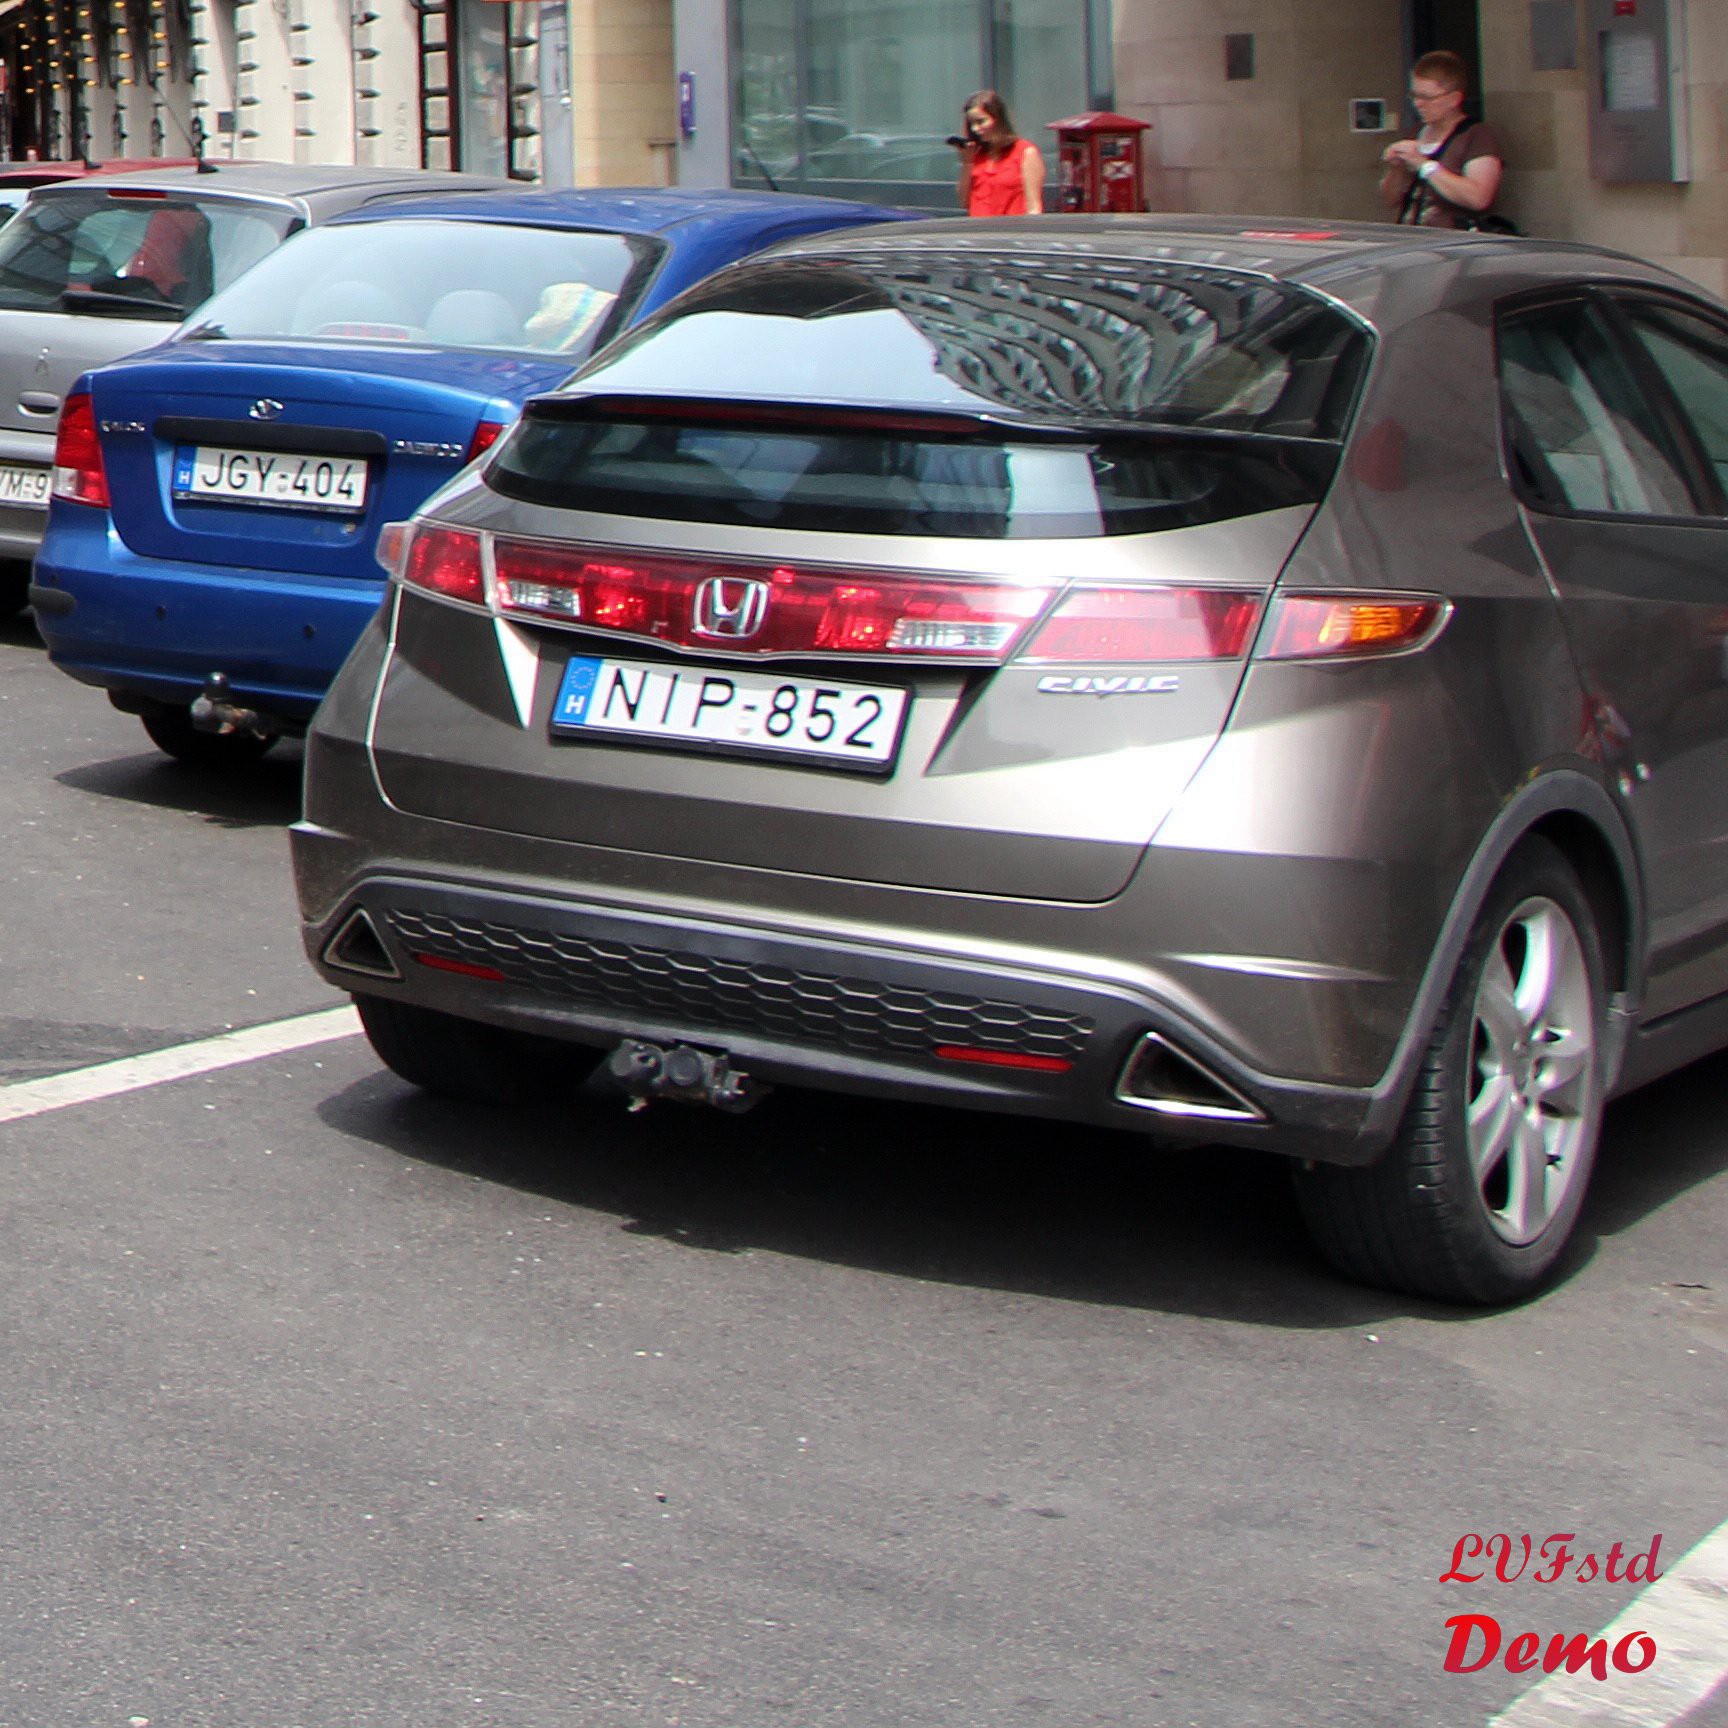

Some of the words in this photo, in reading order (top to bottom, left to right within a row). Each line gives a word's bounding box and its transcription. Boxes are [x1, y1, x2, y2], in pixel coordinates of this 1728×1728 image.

[178, 473, 190, 484] H
[201, 453, 357, 500] JGY-404
[1037, 676, 1180, 696] CIVIC
[566, 695, 586, 715] H
[603, 667, 884, 749] NIP-852
